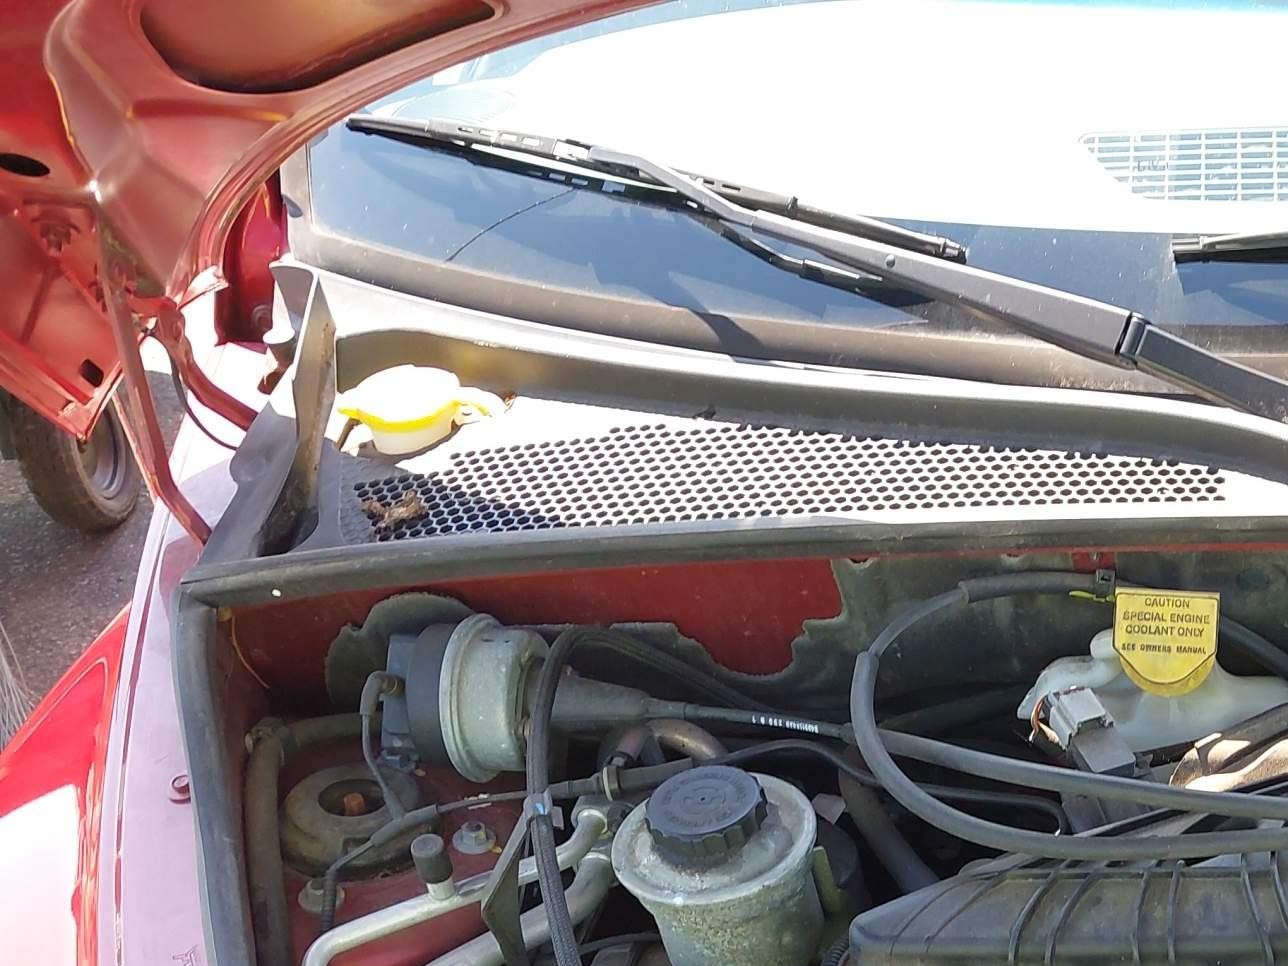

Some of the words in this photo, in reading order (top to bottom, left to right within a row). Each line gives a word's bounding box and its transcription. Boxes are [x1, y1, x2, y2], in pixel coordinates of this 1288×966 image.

[1144, 598, 1190, 608] CAUTION
[1123, 611, 1167, 622] SPECIAL
[1169, 613, 1210, 625] ENGINE
[1125, 624, 1175, 636] COOLANT
[1177, 627, 1205, 638] ONLY
[1121, 643, 1136, 651] SEE
[1140, 643, 1172, 653] OWNERS
[1176, 645, 1207, 655] MANUAL
